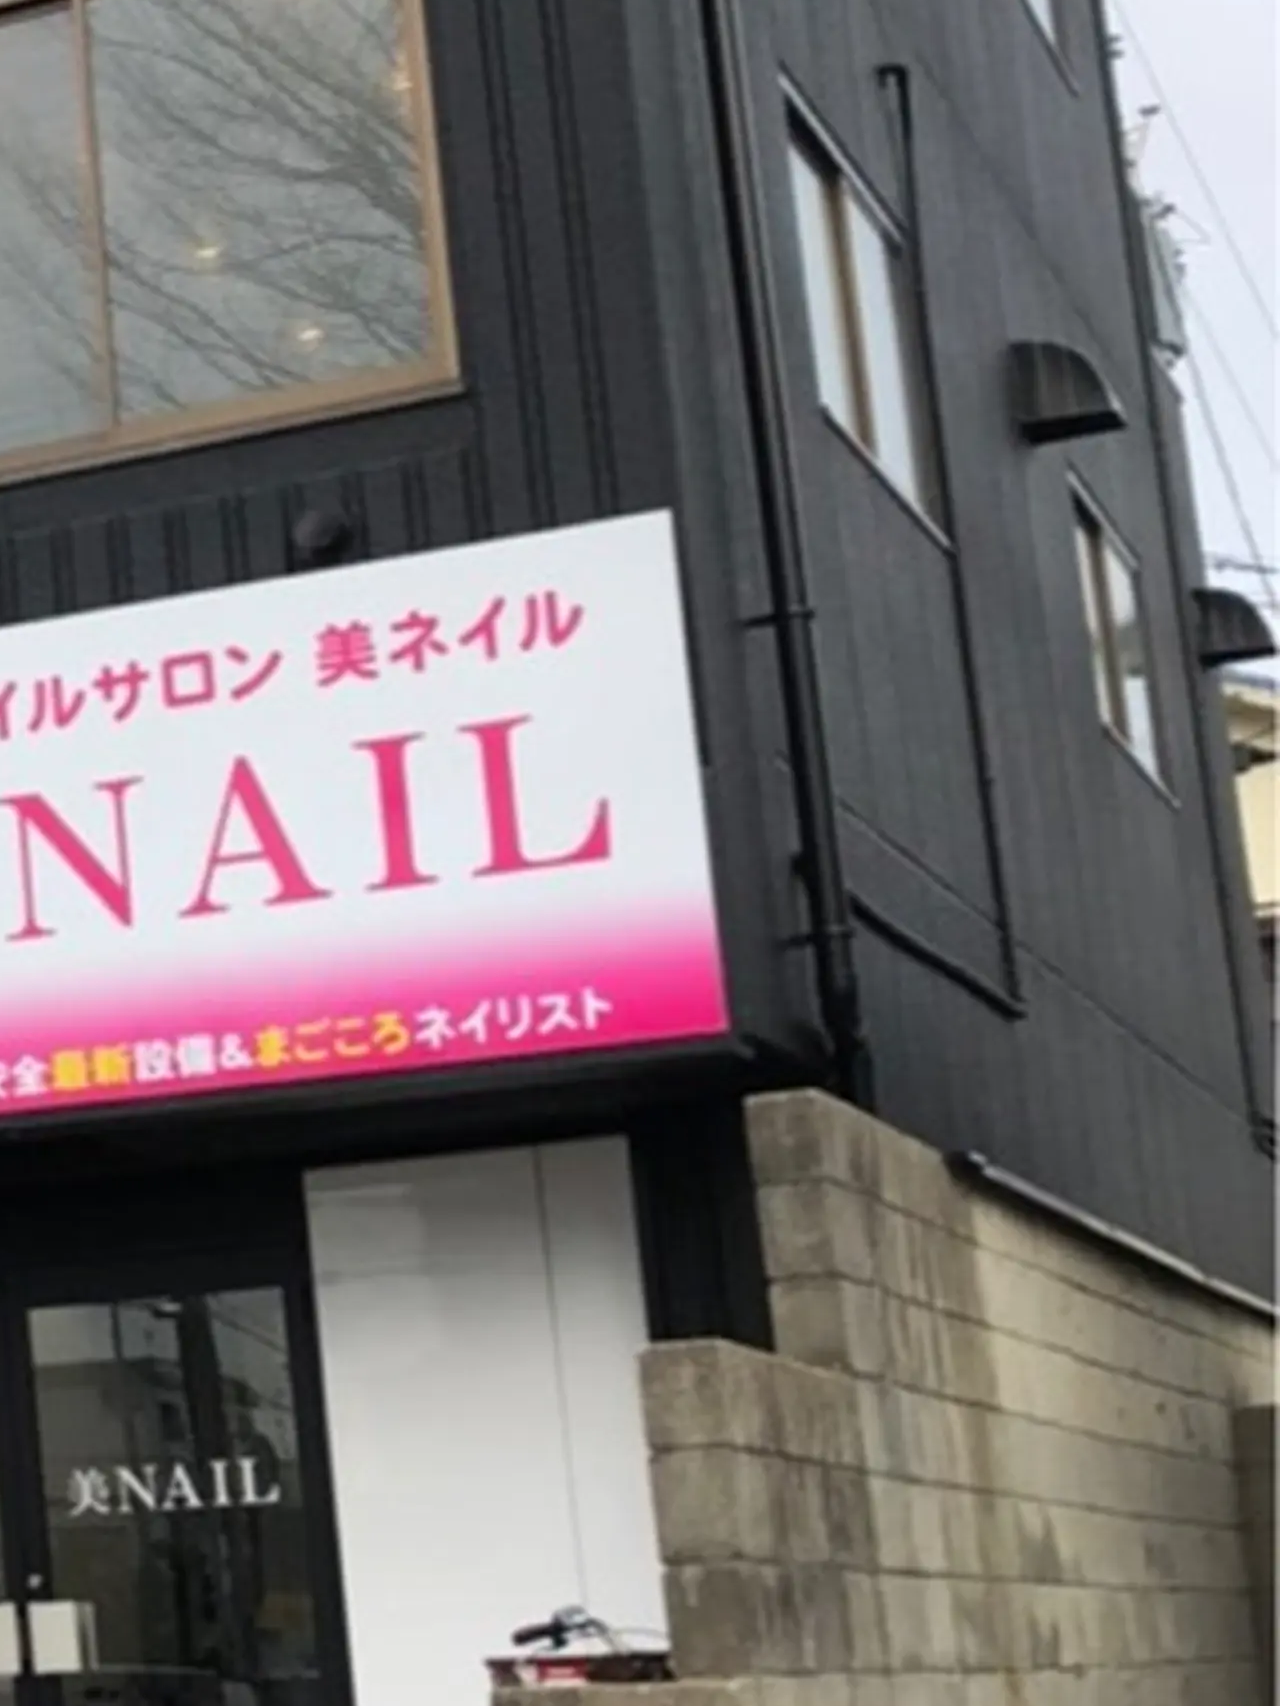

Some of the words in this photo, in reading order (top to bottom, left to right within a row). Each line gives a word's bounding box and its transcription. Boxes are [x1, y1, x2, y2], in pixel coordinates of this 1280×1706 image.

[314, 589, 584, 687] 美ネイル
[69, 1456, 280, 1517] 美NAIL
